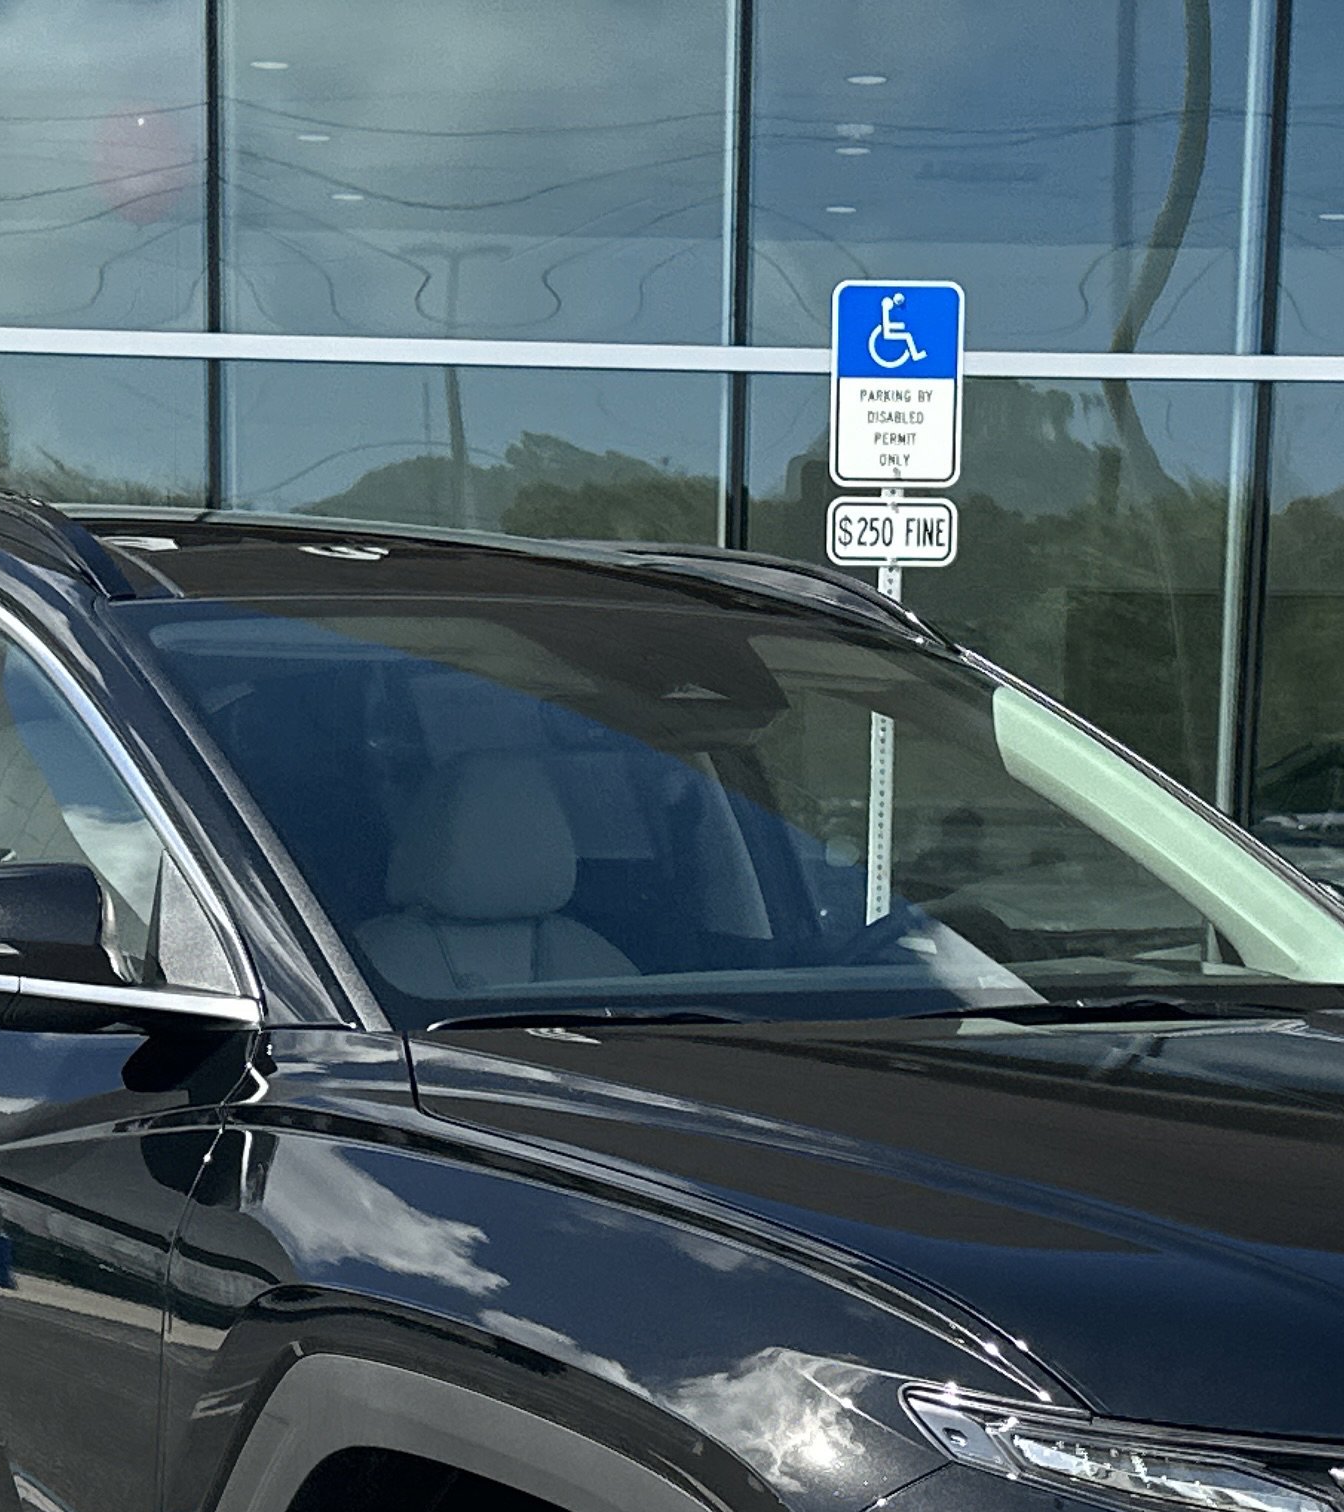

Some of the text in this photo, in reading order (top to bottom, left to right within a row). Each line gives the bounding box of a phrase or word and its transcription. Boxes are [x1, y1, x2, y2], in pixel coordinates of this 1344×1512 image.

[859, 389, 933, 403] PARKING BY
[867, 410, 924, 425] DISABLED
[873, 431, 917, 446] PERMIT
[879, 453, 911, 467] ONLY
[838, 514, 946, 549] $250 FINE
